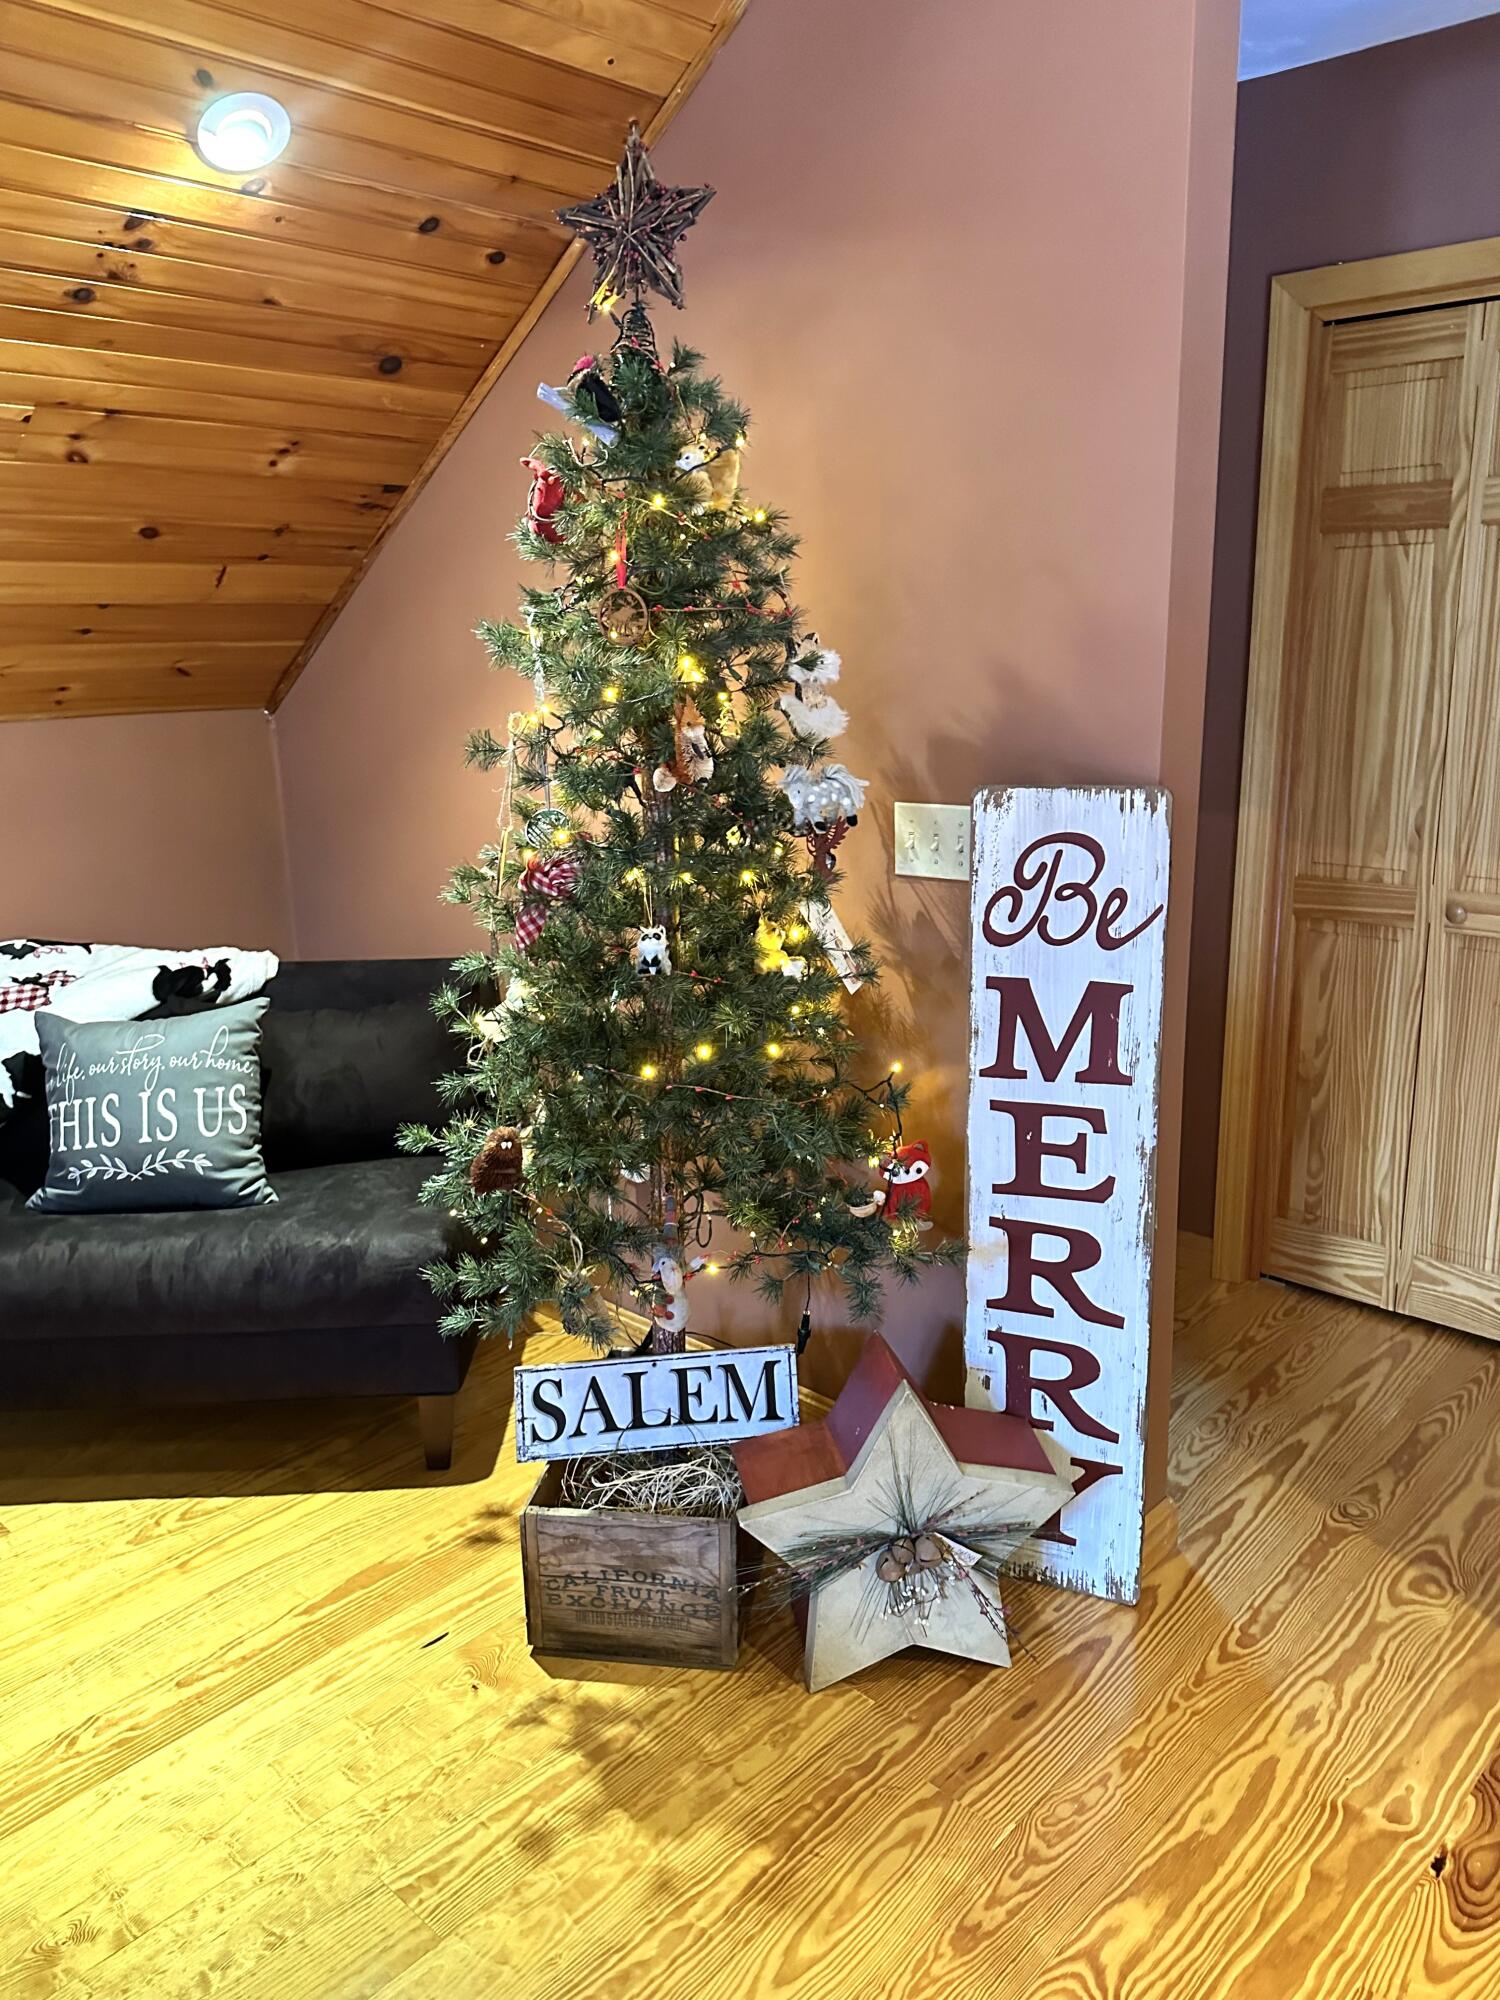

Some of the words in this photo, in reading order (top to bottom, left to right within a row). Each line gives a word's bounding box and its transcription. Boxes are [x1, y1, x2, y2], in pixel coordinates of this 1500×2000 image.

[982, 832, 1164, 952] Be
[88, 1056, 120, 1076] our
[116, 1033, 166, 1093] story.
[169, 1051, 203, 1070] our
[137, 1087, 178, 1144] IS
[193, 1083, 248, 1138] US
[530, 1359, 786, 1444] SALEM
[545, 1568, 721, 1604] CALIFORNIA
[545, 1593, 721, 1619] EXCHANGE
[594, 1584, 671, 1601] FRUIT
